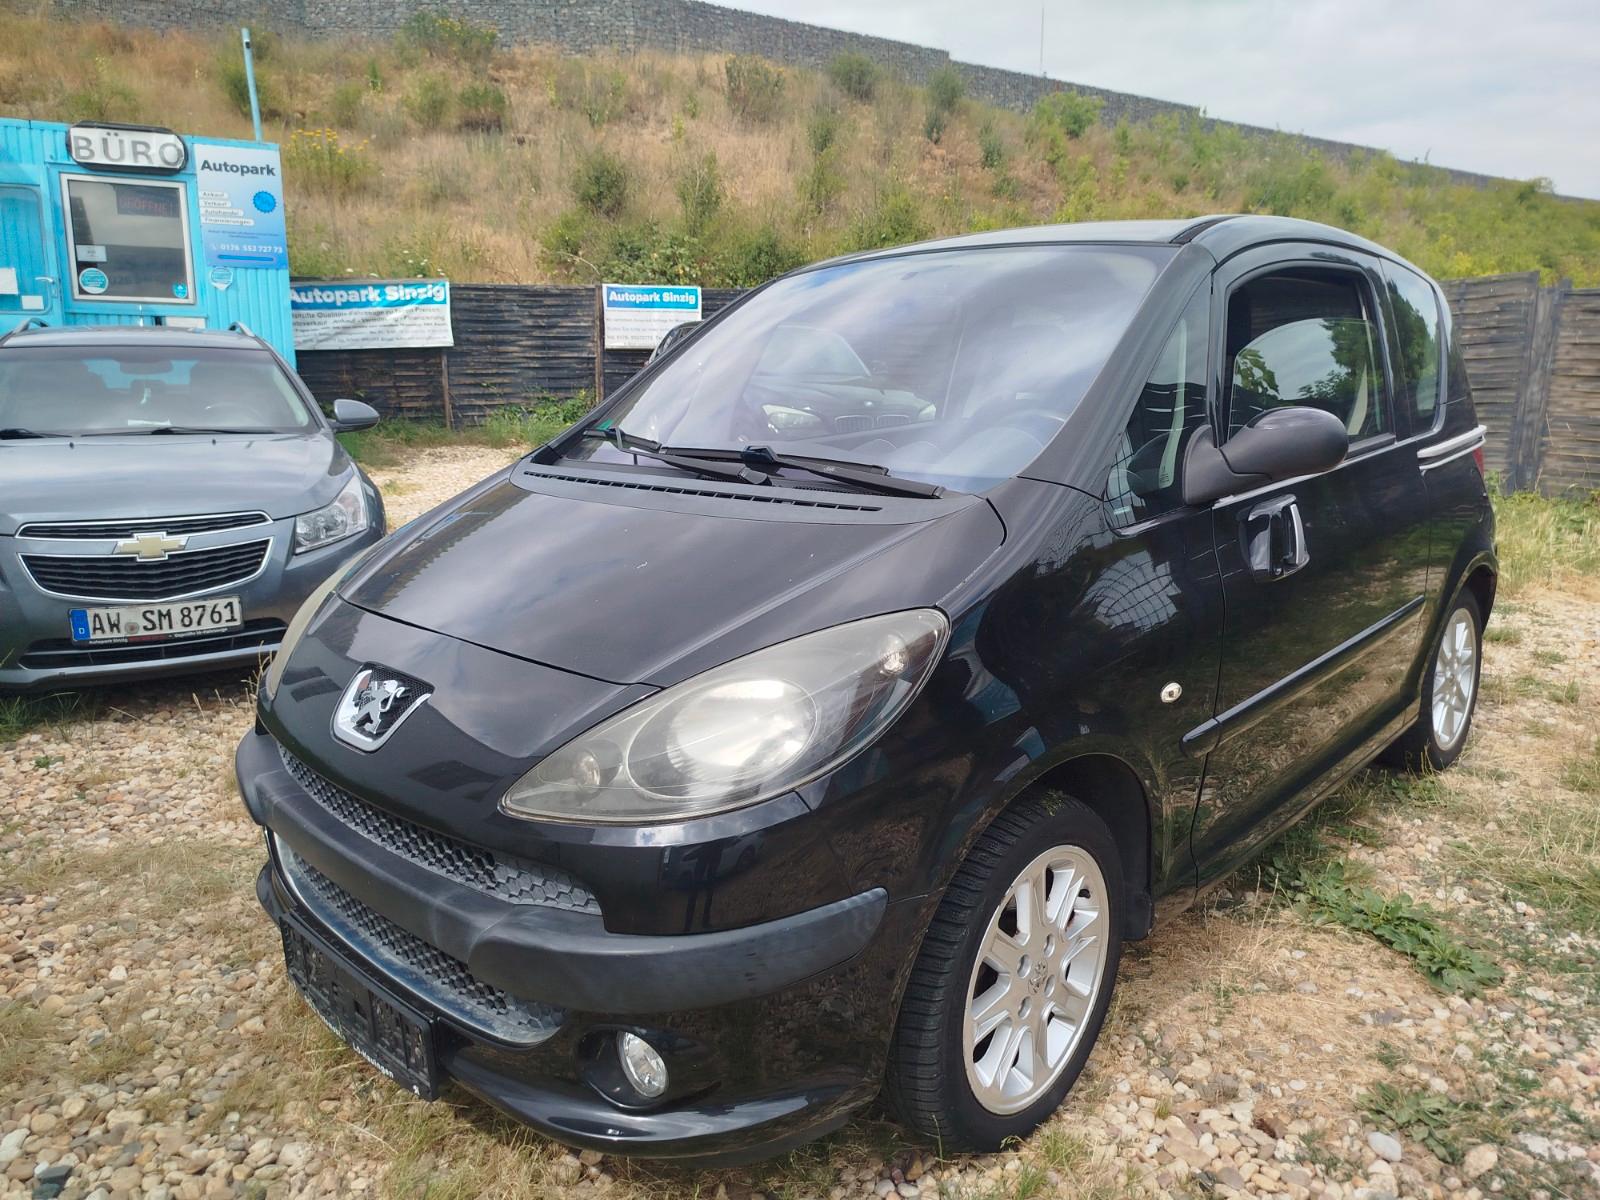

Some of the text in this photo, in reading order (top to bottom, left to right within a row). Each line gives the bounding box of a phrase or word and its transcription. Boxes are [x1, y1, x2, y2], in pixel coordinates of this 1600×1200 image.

[73, 132, 183, 167] BÜRO
[200, 159, 276, 176] Autopark
[291, 284, 446, 306] Autopark Sinzig
[609, 291, 696, 304] Autopark Sinzig
[92, 601, 238, 635] AW SM 8761
[78, 627, 85, 635] D
